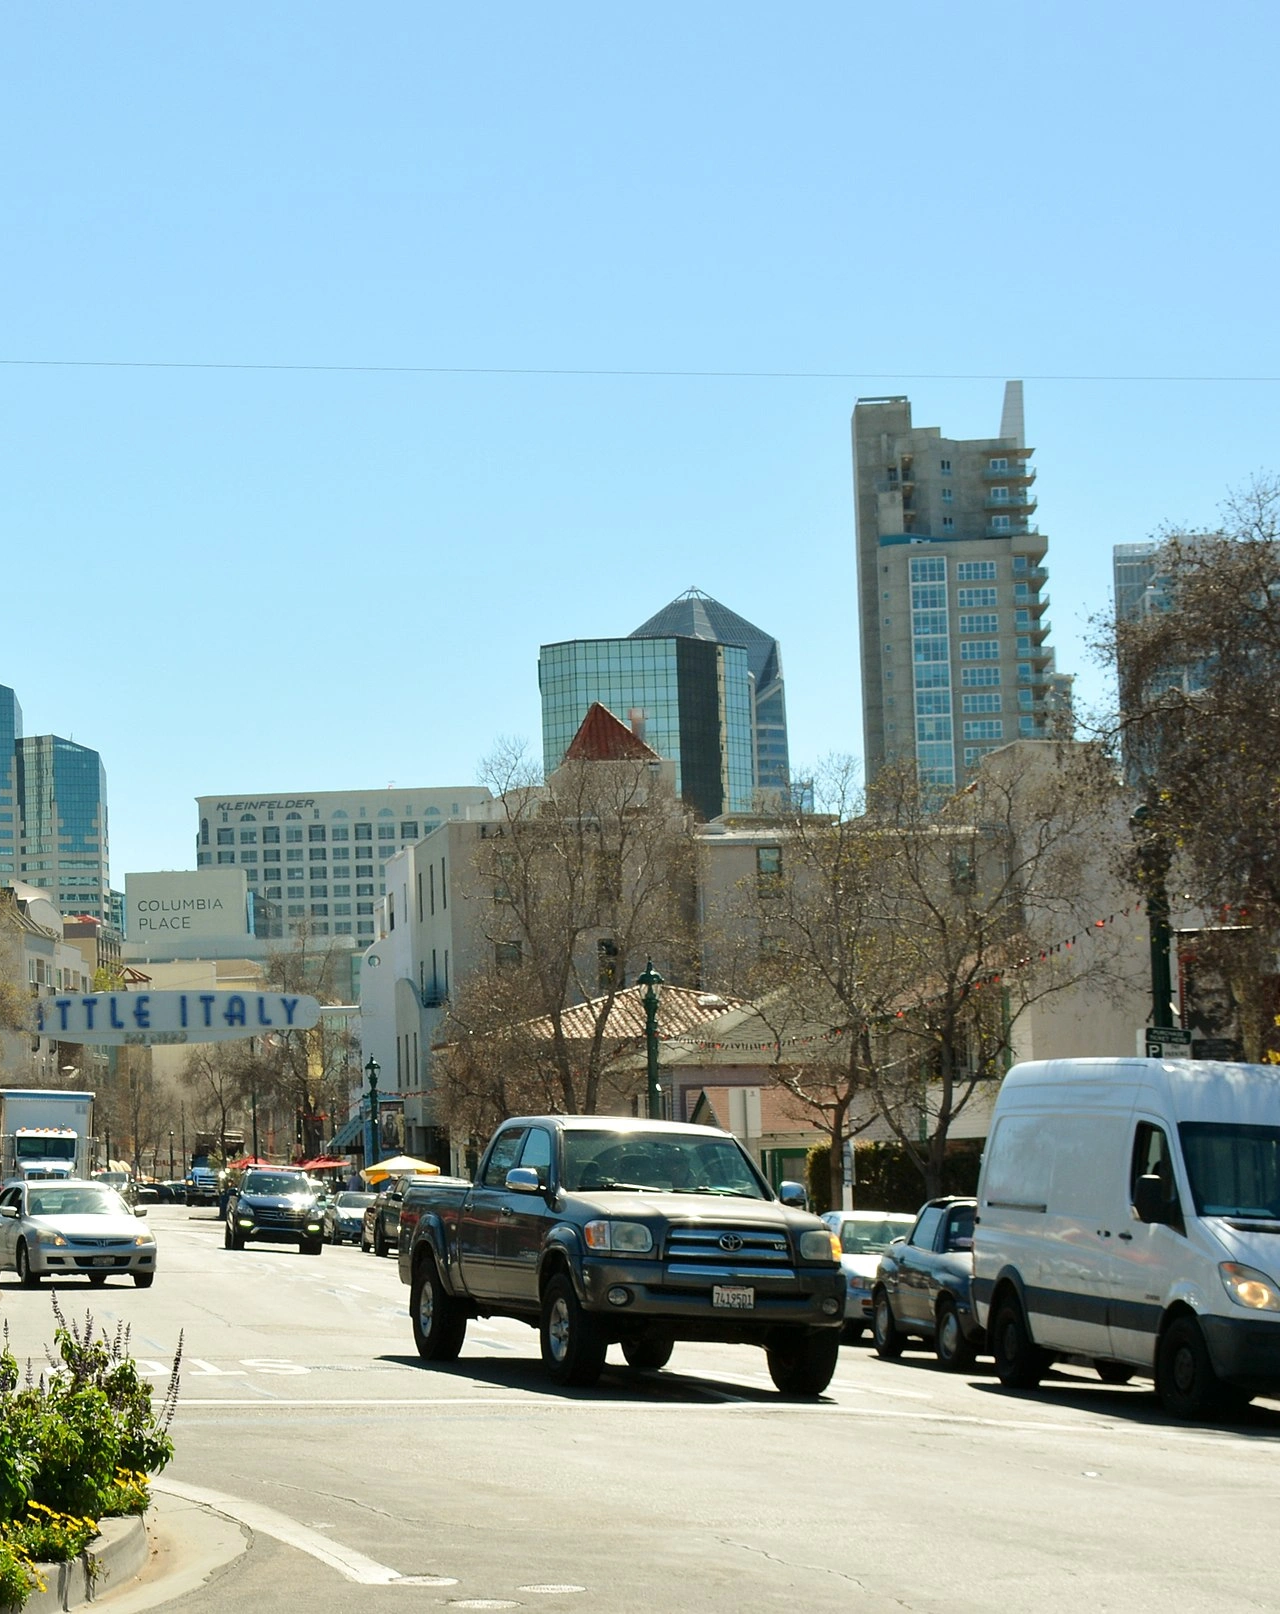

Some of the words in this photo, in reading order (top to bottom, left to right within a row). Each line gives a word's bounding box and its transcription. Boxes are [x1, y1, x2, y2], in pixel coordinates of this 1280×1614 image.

[216, 799, 316, 811] KLEINFELDER
[137, 898, 224, 912] COLUMBIA
[139, 916, 191, 930] PLACE
[37, 995, 150, 1031] ITTLE
[179, 994, 300, 1027] ITALY
[1148, 1045, 1160, 1058] P
